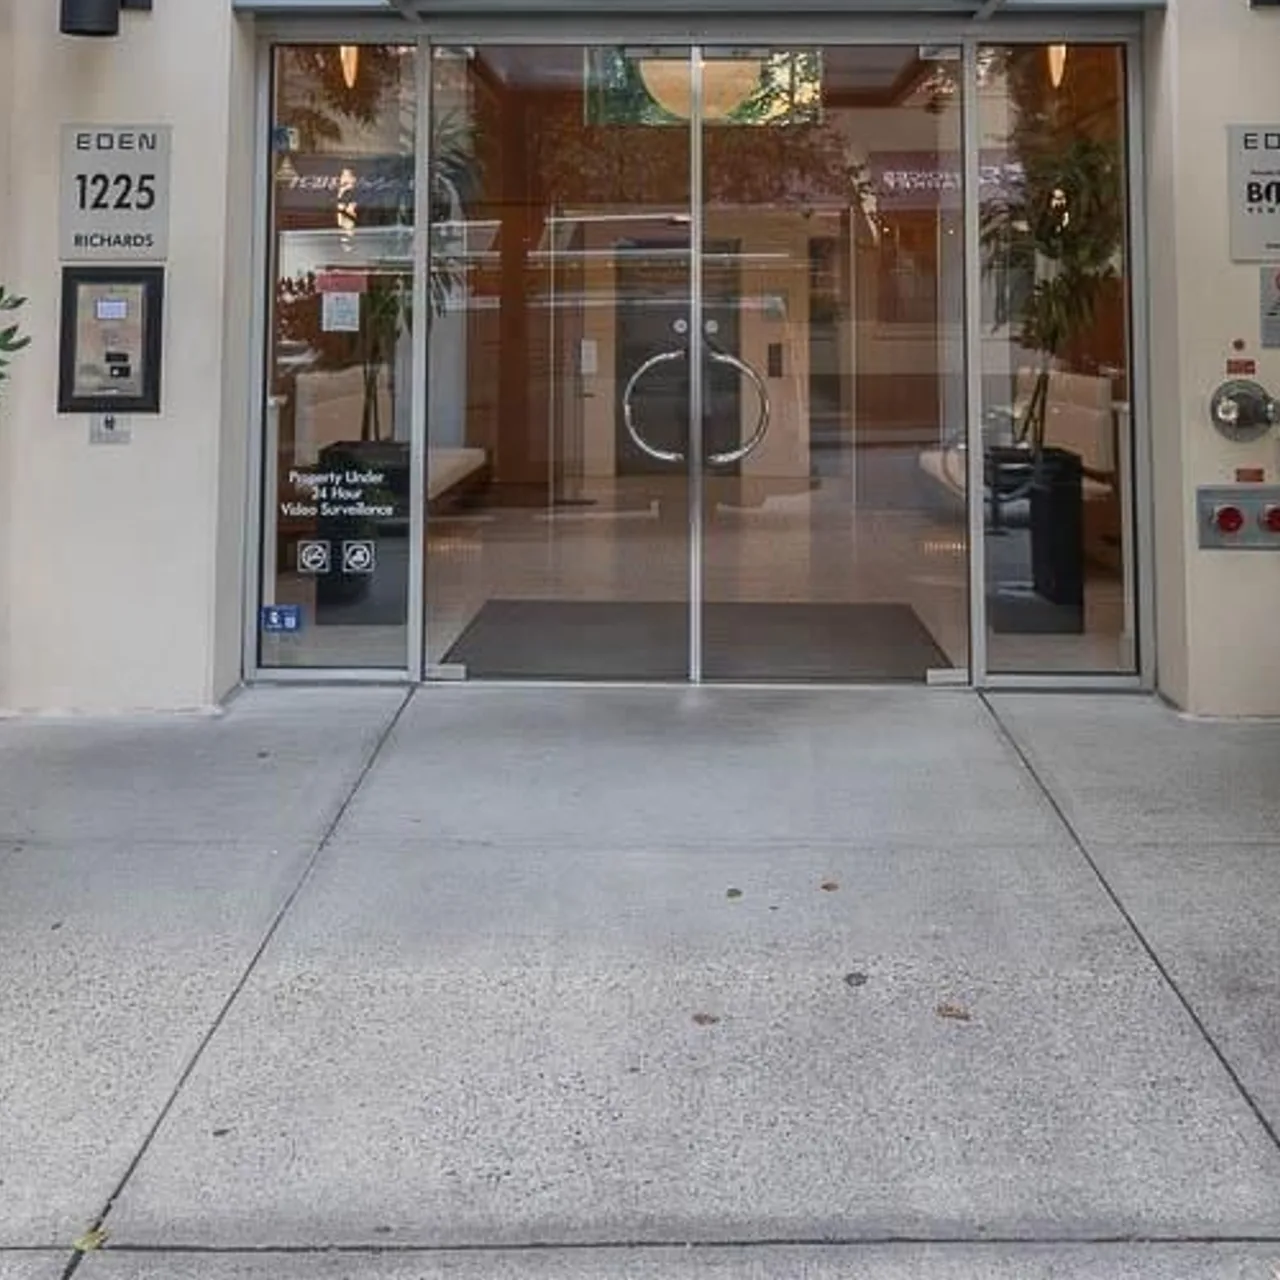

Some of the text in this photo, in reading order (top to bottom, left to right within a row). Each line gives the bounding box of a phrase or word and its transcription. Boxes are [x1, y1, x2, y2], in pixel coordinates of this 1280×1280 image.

[76, 133, 157, 151] EDEN
[75, 174, 156, 210] 1225
[73, 233, 155, 248] RICHARDS
[289, 471, 384, 485] Property Under
[312, 486, 363, 500] 24 Hour
[280, 502, 393, 516] Video Surveillance
